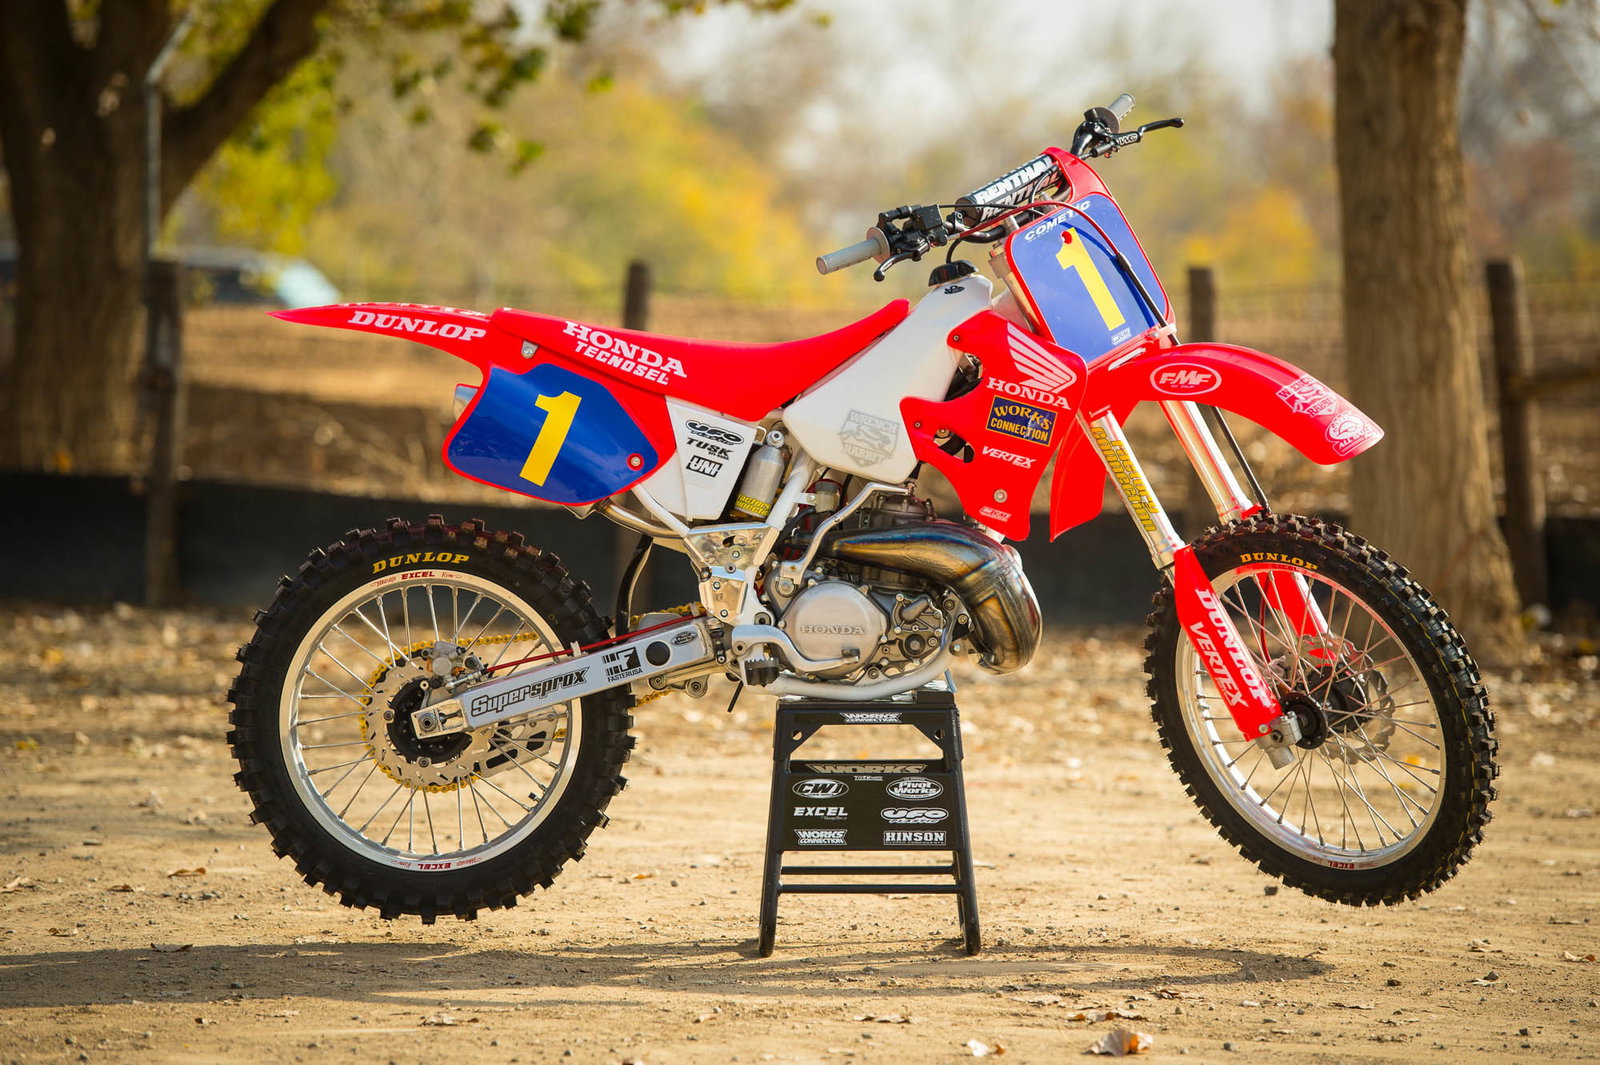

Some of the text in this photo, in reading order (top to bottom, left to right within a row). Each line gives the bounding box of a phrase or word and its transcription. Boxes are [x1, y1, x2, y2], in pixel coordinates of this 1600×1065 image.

[1056, 227, 1126, 331] 1
[347, 310, 487, 341] DUNLOP
[563, 321, 687, 378] HONDA
[575, 341, 669, 385] TECNOSEL
[1159, 370, 1212, 385] FMF
[986, 377, 1071, 411] HONDA
[994, 405, 1052, 430] WORKS
[519, 391, 582, 487] 1
[687, 421, 743, 443] UFO
[990, 417, 1049, 441] CONNECTION
[687, 437, 734, 458] TUSK
[982, 446, 1037, 468] VERTEX
[688, 456, 722, 477] UNI
[372, 552, 470, 574] DUNLOP
[1240, 552, 1318, 570] DUNLOP
[401, 571, 435, 580] EXCEL
[800, 625, 865, 635] HONDA
[1195, 588, 1274, 708] DUNLOP
[1190, 621, 1249, 707] VERTEX
[470, 667, 591, 717] Supersprox
[813, 764, 924, 773] WORKS
[794, 806, 848, 816] EXCEL
[883, 809, 947, 819] UFO
[797, 830, 845, 838] WORKS
[885, 832, 944, 842] HINSON
[418, 862, 451, 870] EXCEL
